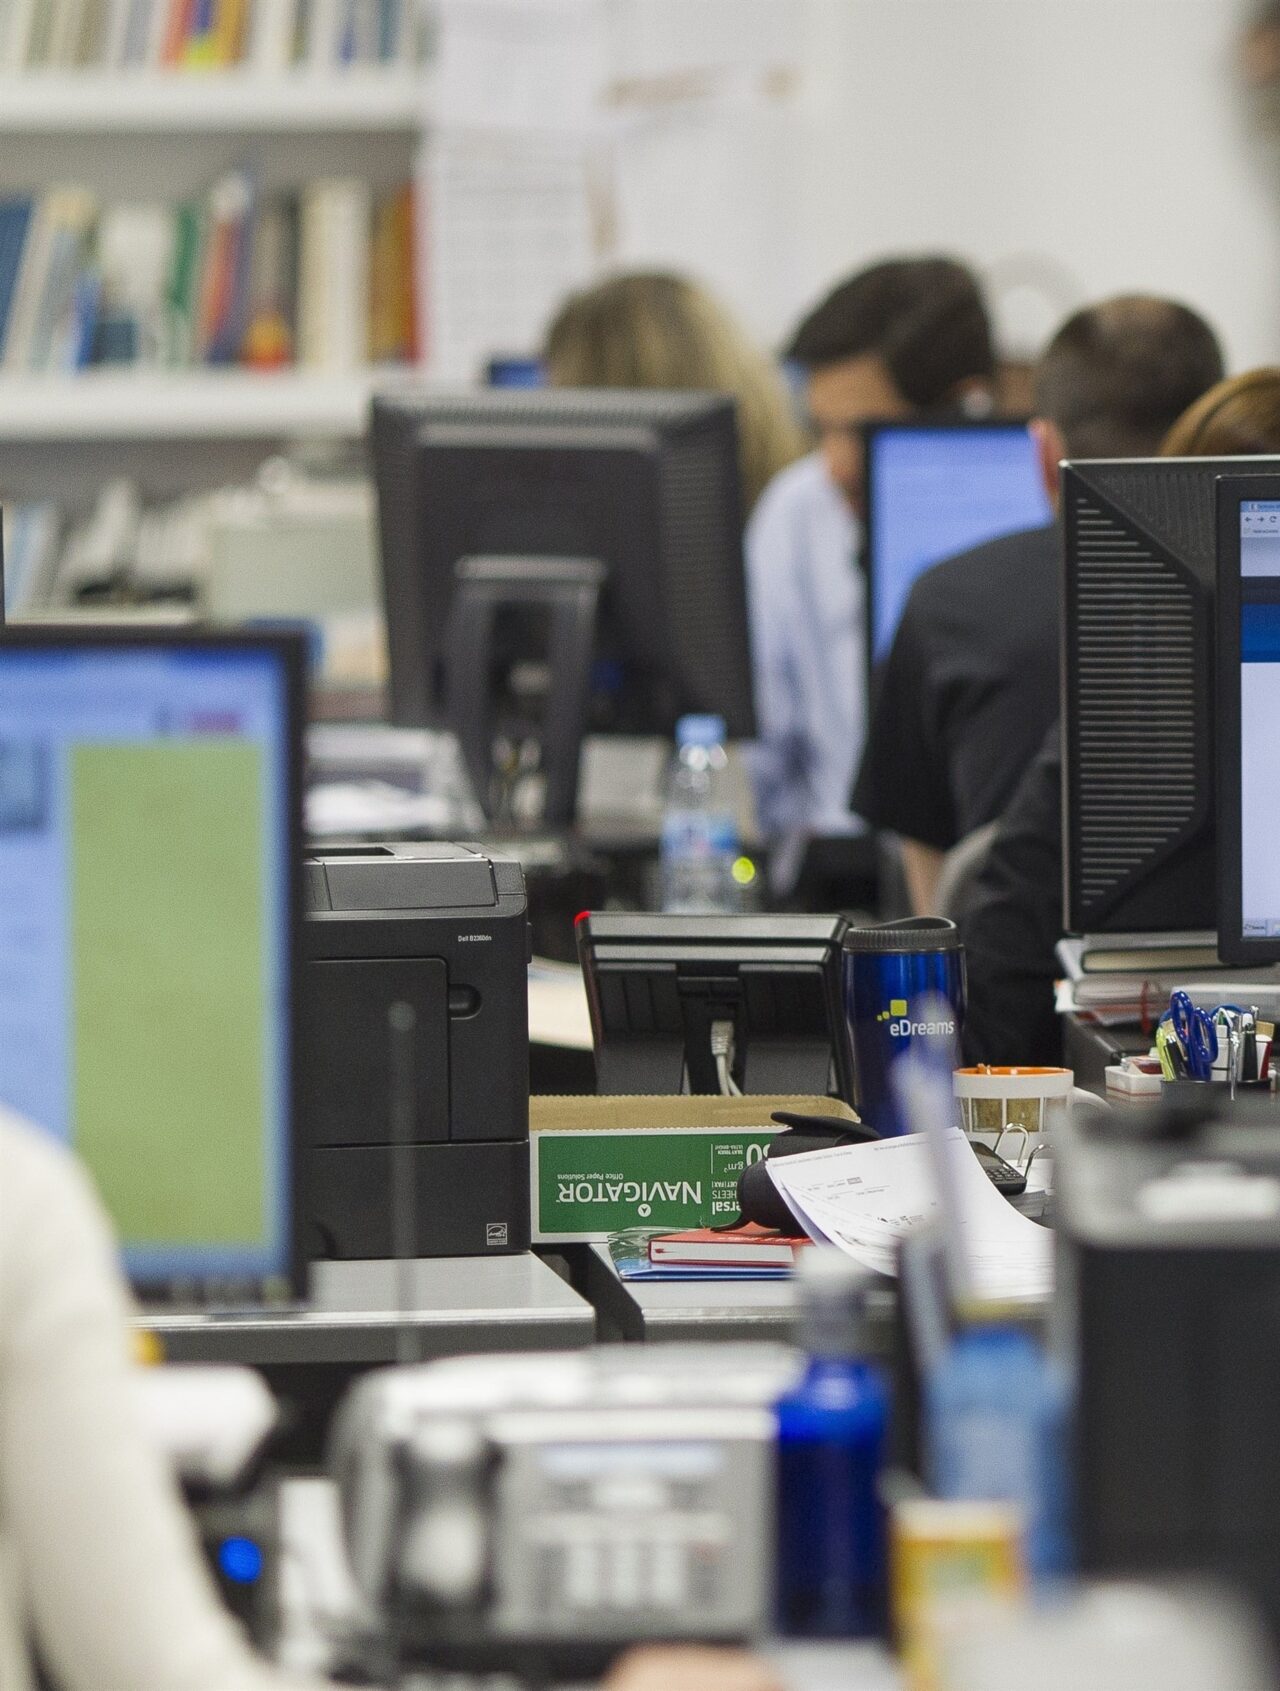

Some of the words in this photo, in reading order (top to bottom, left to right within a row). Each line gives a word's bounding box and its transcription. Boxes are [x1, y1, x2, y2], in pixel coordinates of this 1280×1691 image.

[890, 1019, 955, 1036] eDreams
[558, 1181, 702, 1204] NAVIGATOR
[712, 1190, 736, 1199] HEETS
